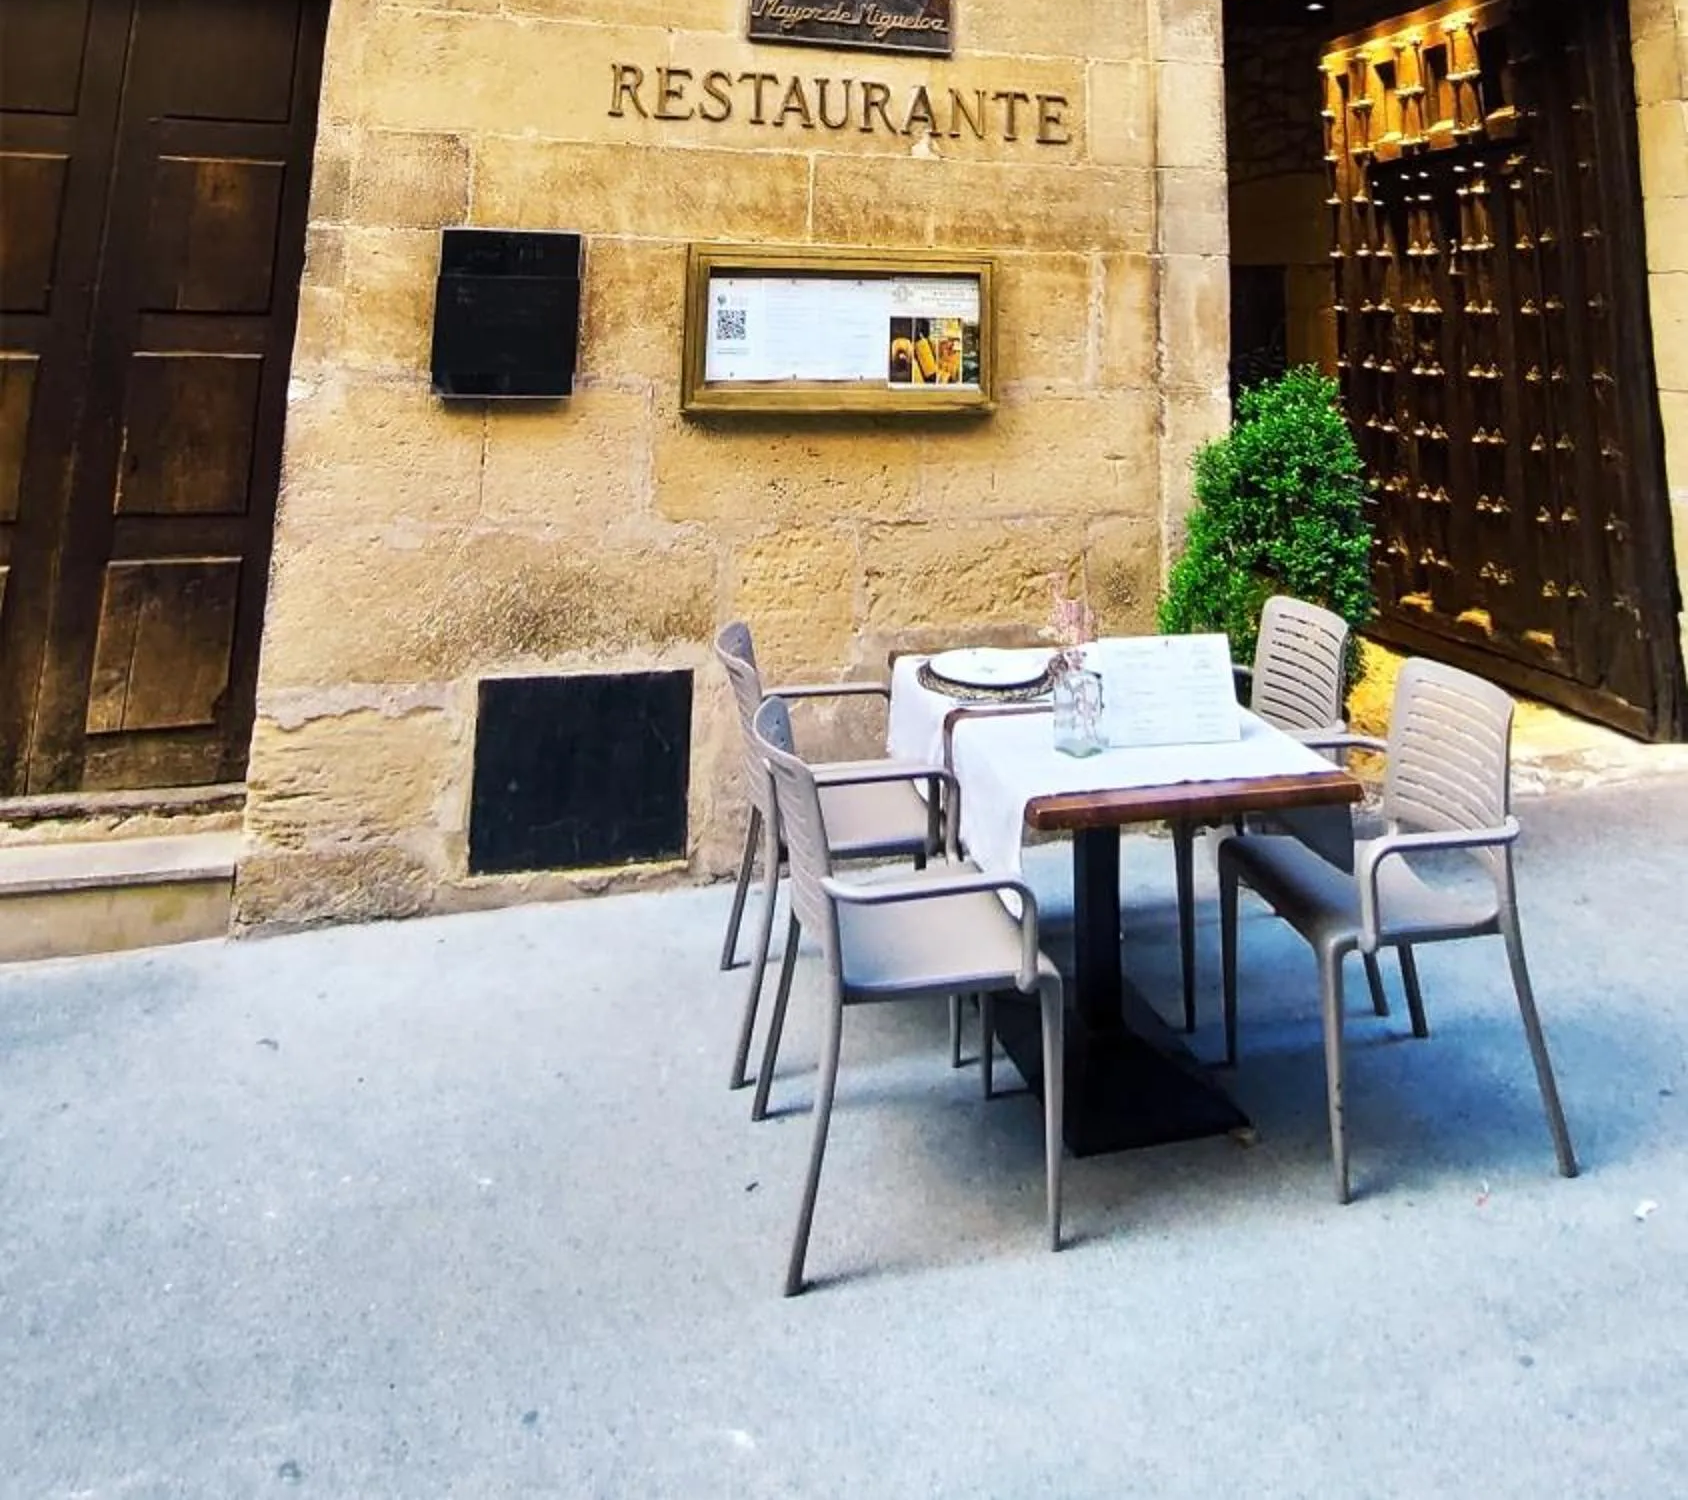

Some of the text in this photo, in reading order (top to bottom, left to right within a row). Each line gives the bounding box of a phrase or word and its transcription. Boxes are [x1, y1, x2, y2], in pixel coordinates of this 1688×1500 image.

[825, 1, 852, 24] de
[852, 2, 950, 40] Migueloa
[607, 62, 1072, 145] RESTAURANTE
